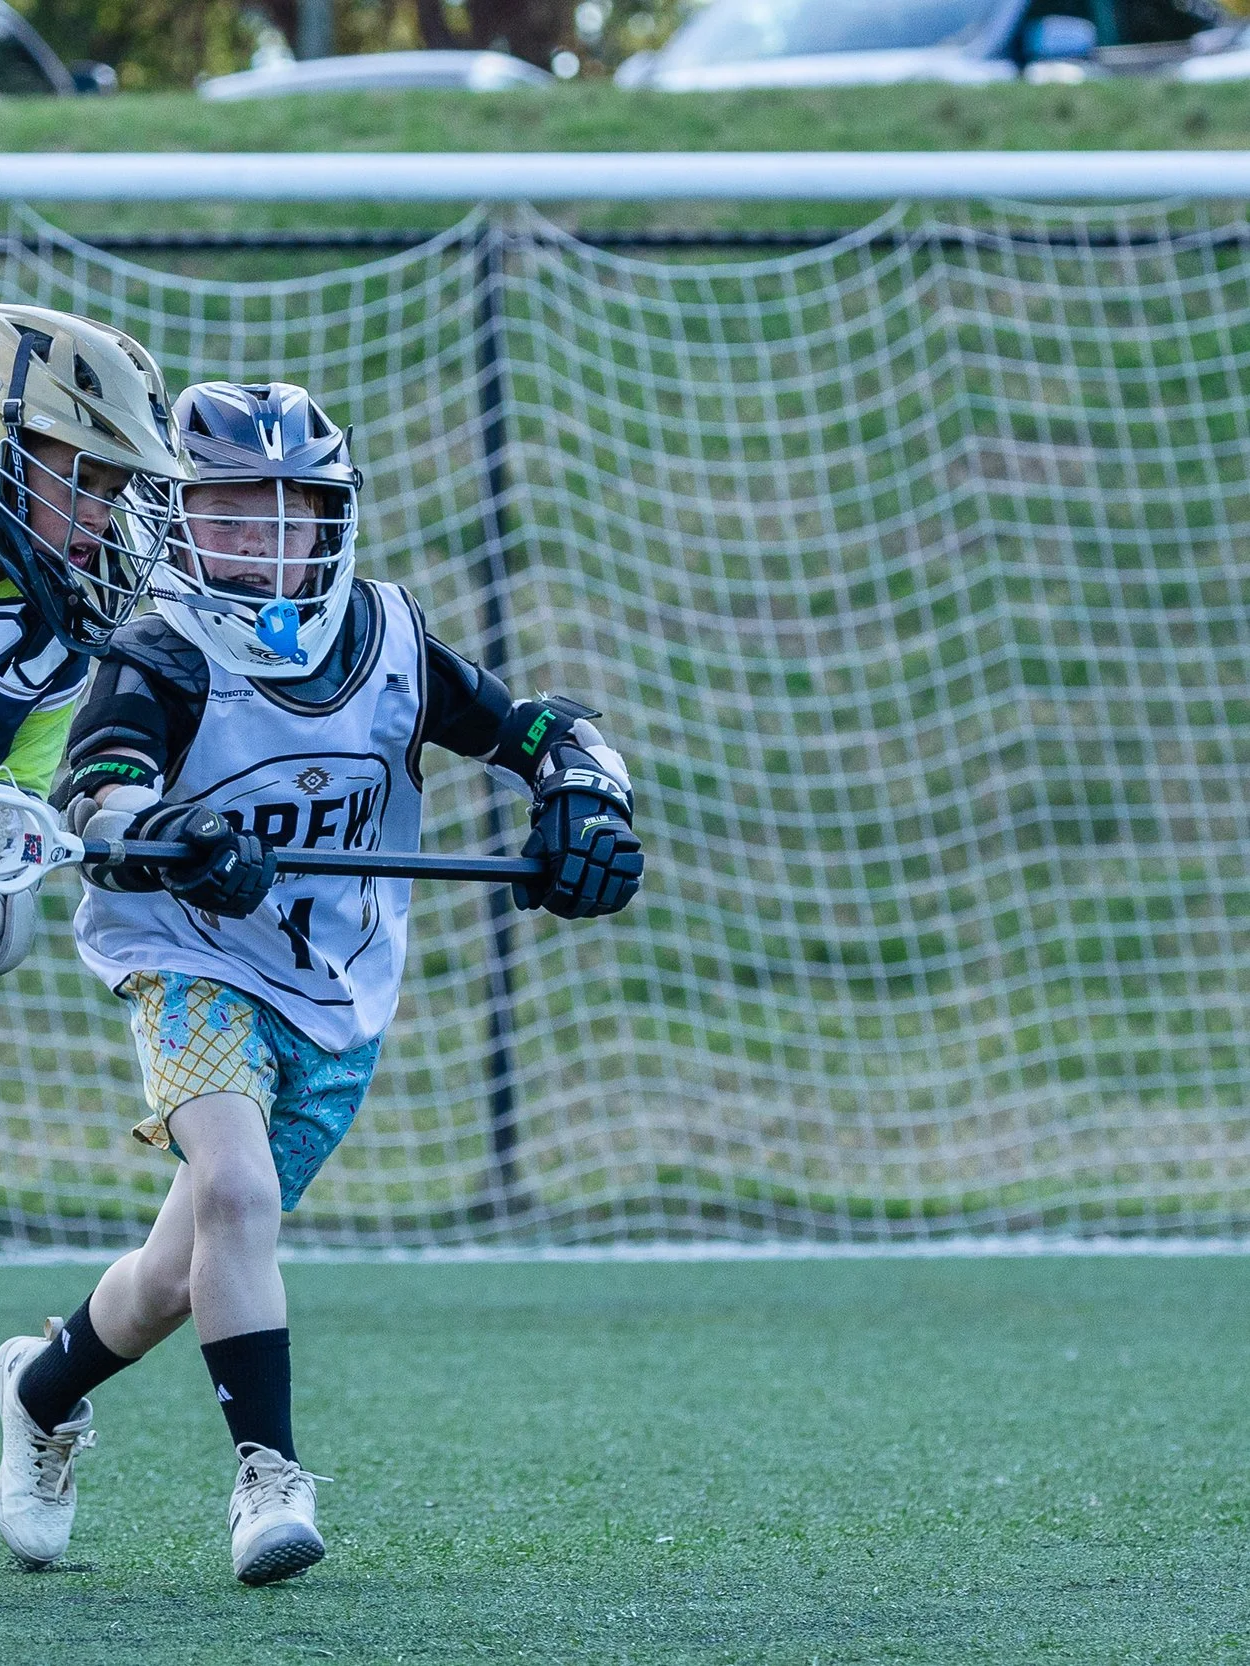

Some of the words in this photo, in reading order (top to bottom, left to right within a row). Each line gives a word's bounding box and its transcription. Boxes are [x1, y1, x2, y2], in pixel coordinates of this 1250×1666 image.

[521, 708, 557, 756] LEFT
[72, 762, 146, 785] RIGHT
[560, 767, 632, 813] STX
